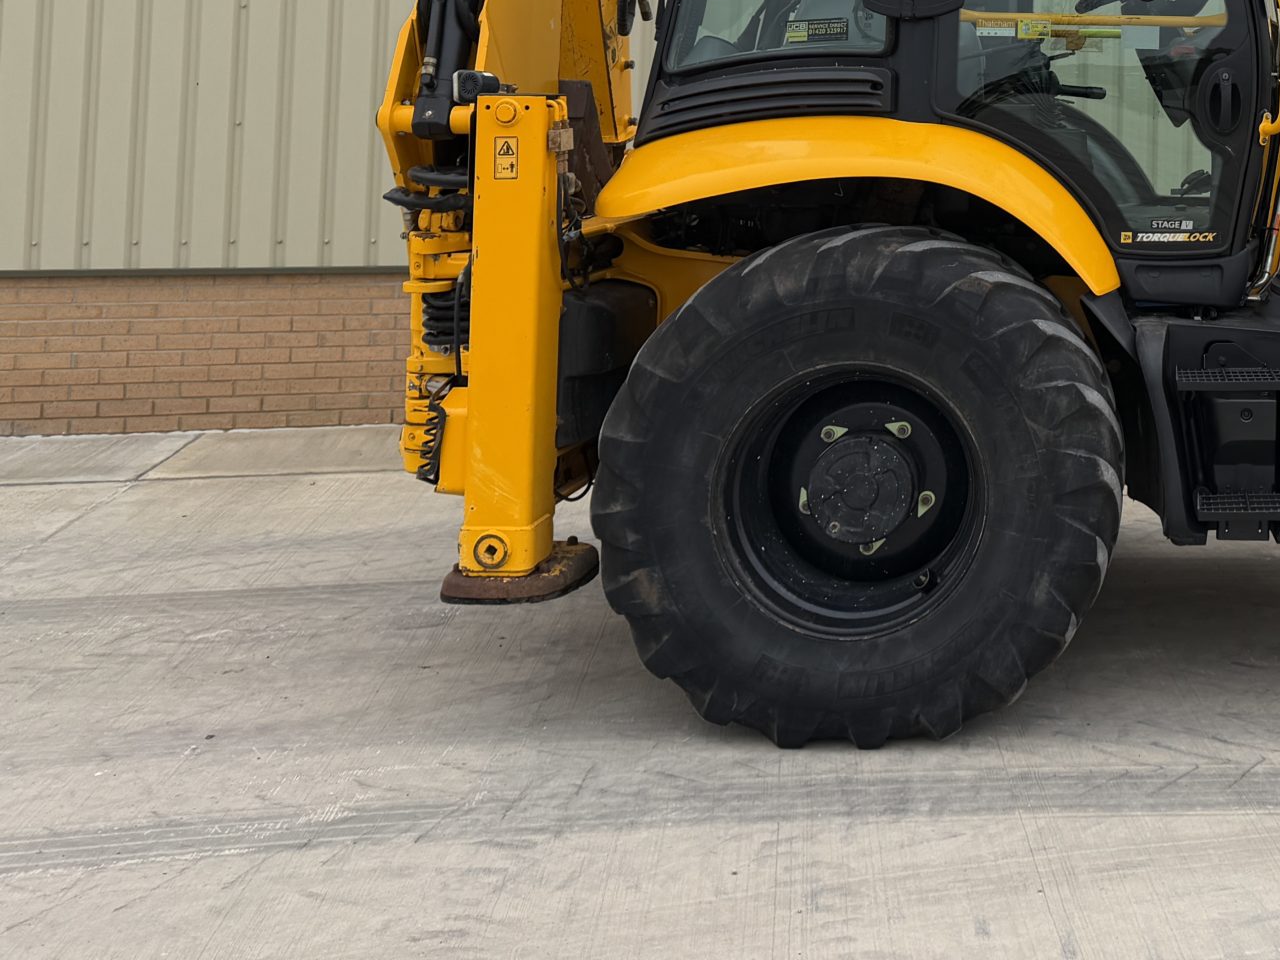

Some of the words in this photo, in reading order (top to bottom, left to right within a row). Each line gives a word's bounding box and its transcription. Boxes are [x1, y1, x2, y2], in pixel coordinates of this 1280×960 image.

[788, 23, 806, 31] JCB
[1151, 220, 1180, 229] STAGE
[1136, 232, 1217, 242] TORQUELOCK
